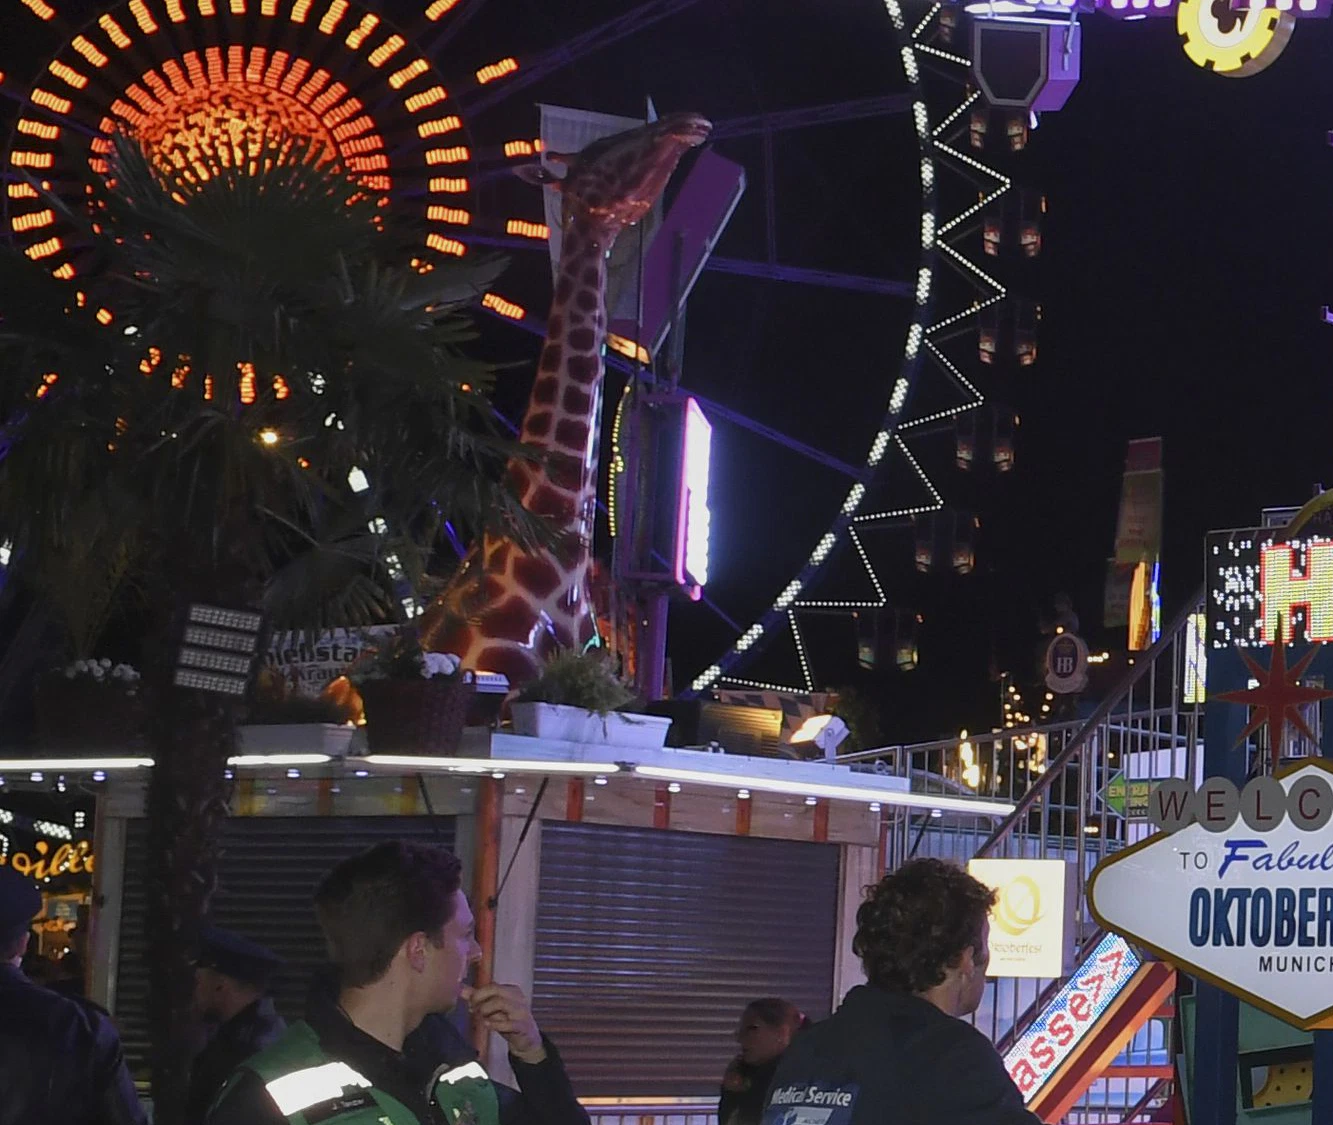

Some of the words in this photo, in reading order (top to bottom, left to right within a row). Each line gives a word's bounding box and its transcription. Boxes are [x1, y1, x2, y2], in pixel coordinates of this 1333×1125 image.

[1180, 852, 1208, 870] TO
[771, 1086, 807, 1104] Medical
[805, 1086, 852, 1107] Service
